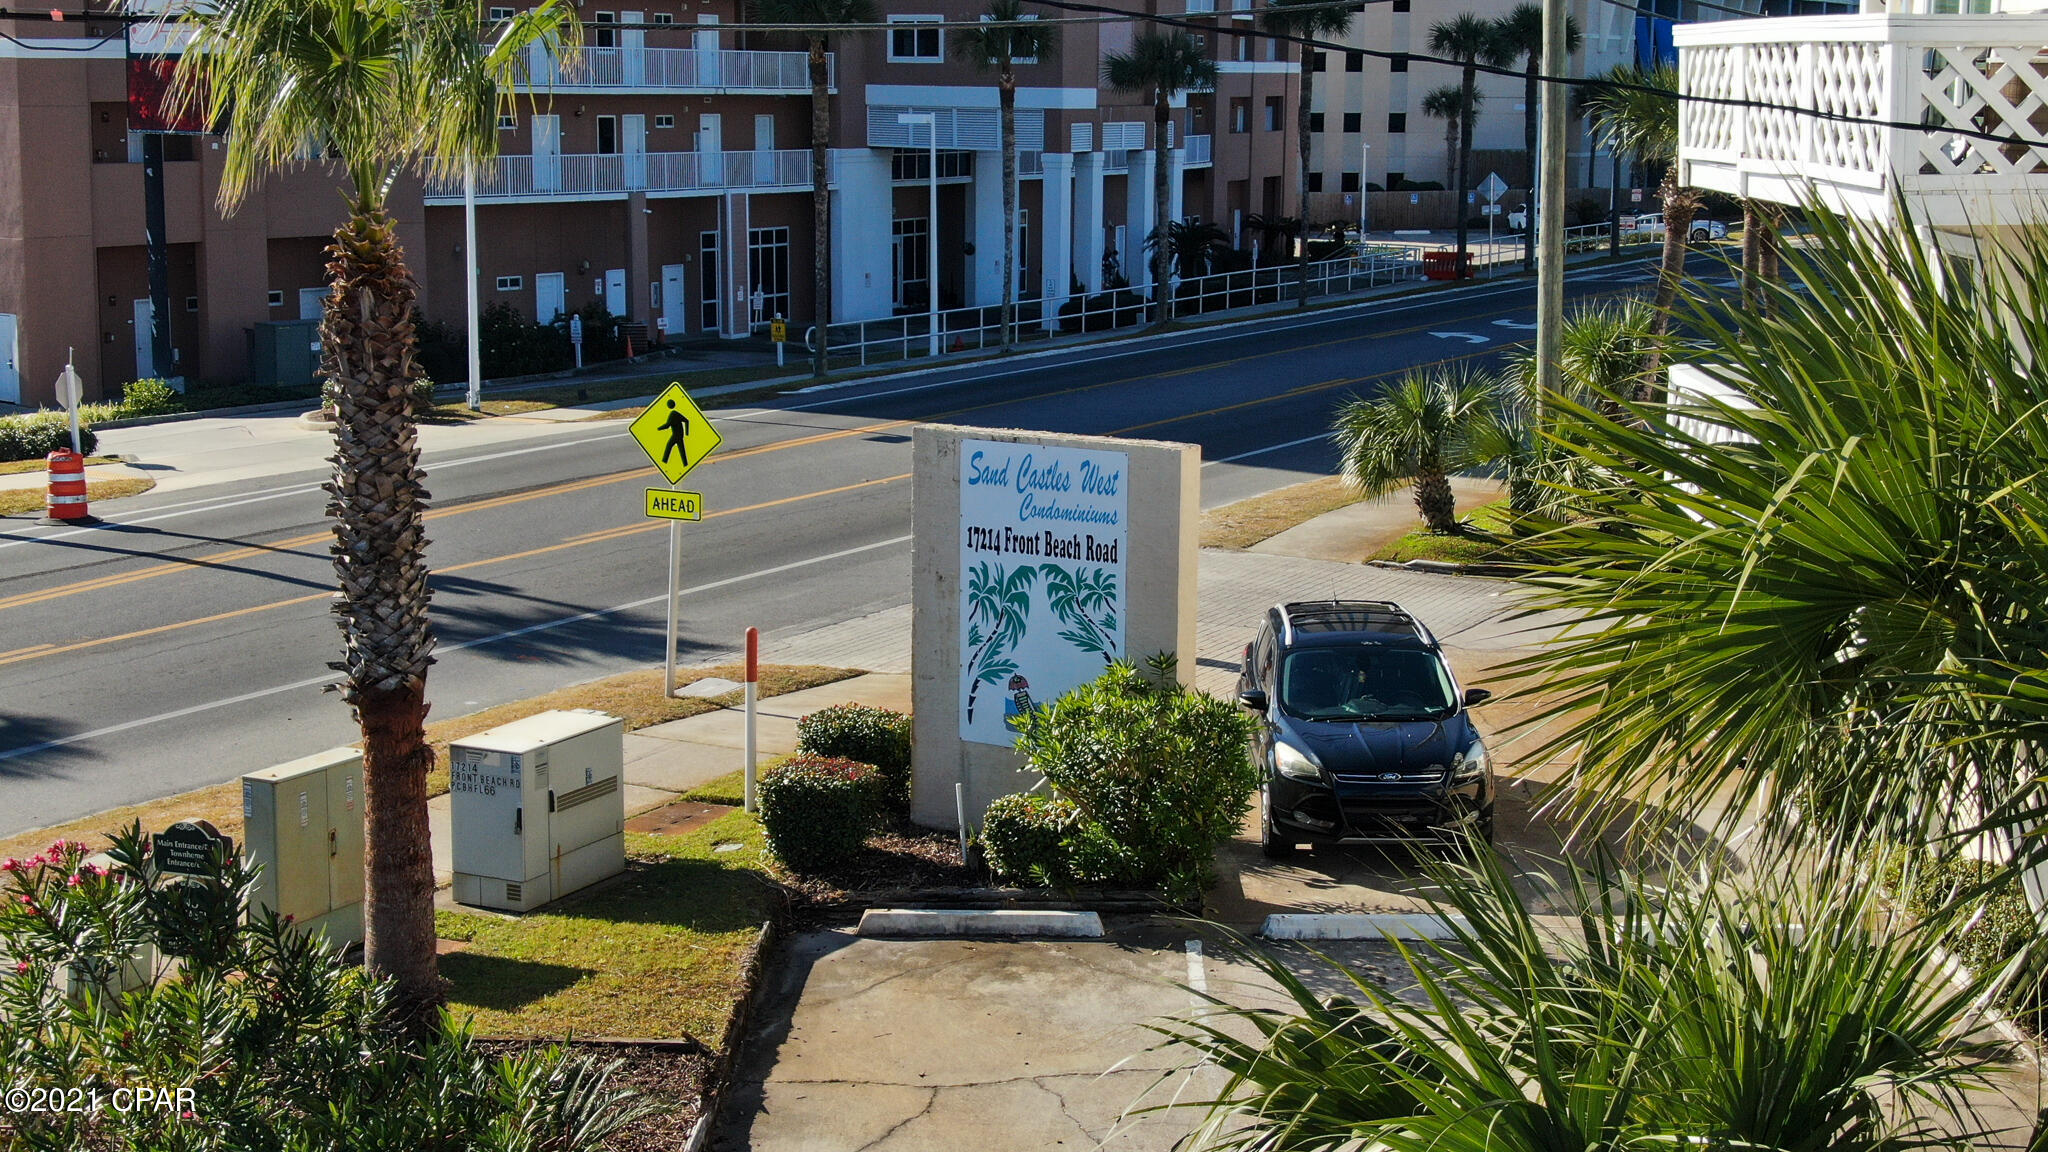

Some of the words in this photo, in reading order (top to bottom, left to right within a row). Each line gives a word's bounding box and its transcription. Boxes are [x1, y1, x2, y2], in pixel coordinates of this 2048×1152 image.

[968, 451, 1010, 487] Sand
[1016, 453, 1071, 494] Castles
[1080, 459, 1120, 496] West
[652, 497, 695, 513] AHEAD
[1019, 492, 1119, 525] Condominiums
[967, 526, 1001, 555] 17214
[1004, 526, 1040, 555] Front
[1044, 530, 1081, 561] Beach
[1086, 534, 1118, 564] Road
[451, 761, 477, 772] 17214
[451, 771, 478, 783] FRONT
[480, 775, 507, 787] BEACH
[509, 778, 521, 789] RD
[157, 839, 174, 847] Main
